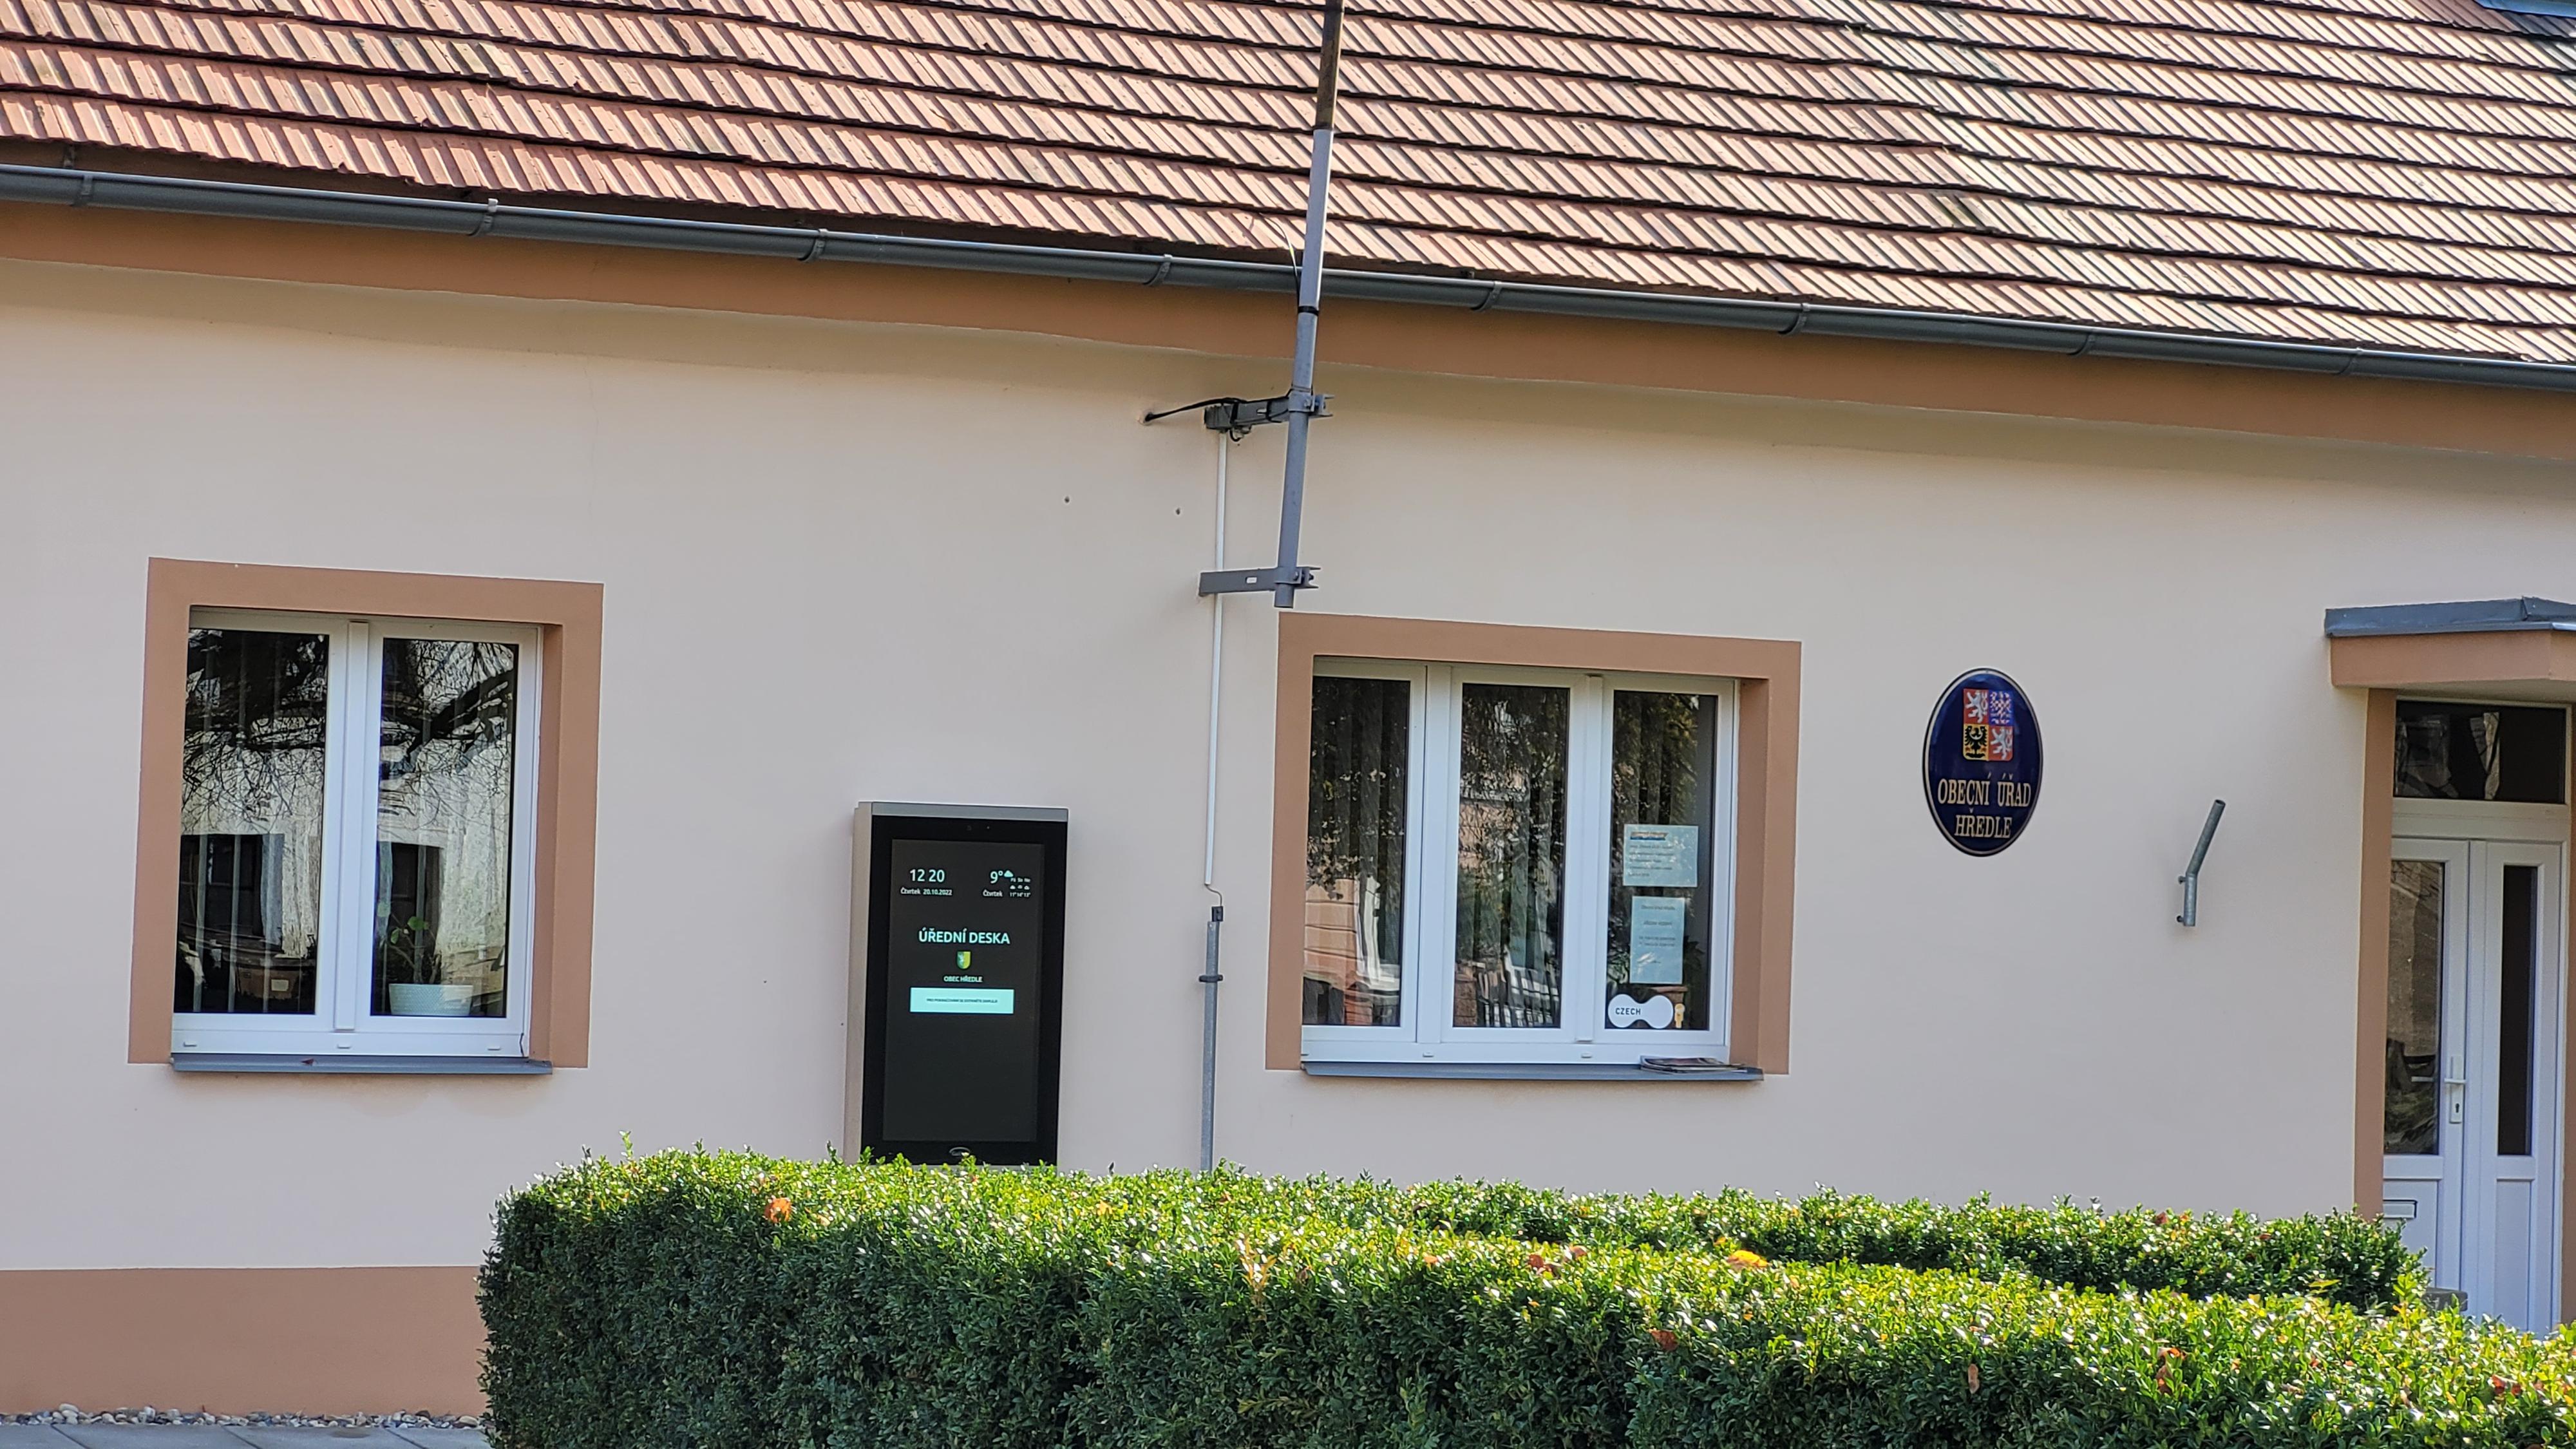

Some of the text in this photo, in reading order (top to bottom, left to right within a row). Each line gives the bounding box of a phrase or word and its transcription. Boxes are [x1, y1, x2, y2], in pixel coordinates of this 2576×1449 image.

[1937, 772, 2031, 807] OBECNÍ ÚŘAD
[1954, 808, 2012, 838] HŘEDLE
[909, 869, 945, 883] 12 20
[990, 870, 1003, 884] 9°
[900, 886, 921, 895] Čtvrtek
[982, 889, 1003, 897] Čtvrtek
[918, 927, 1010, 944] ÚŘEDNÍ DESKA
[960, 974, 983, 983] HŘEDLE
